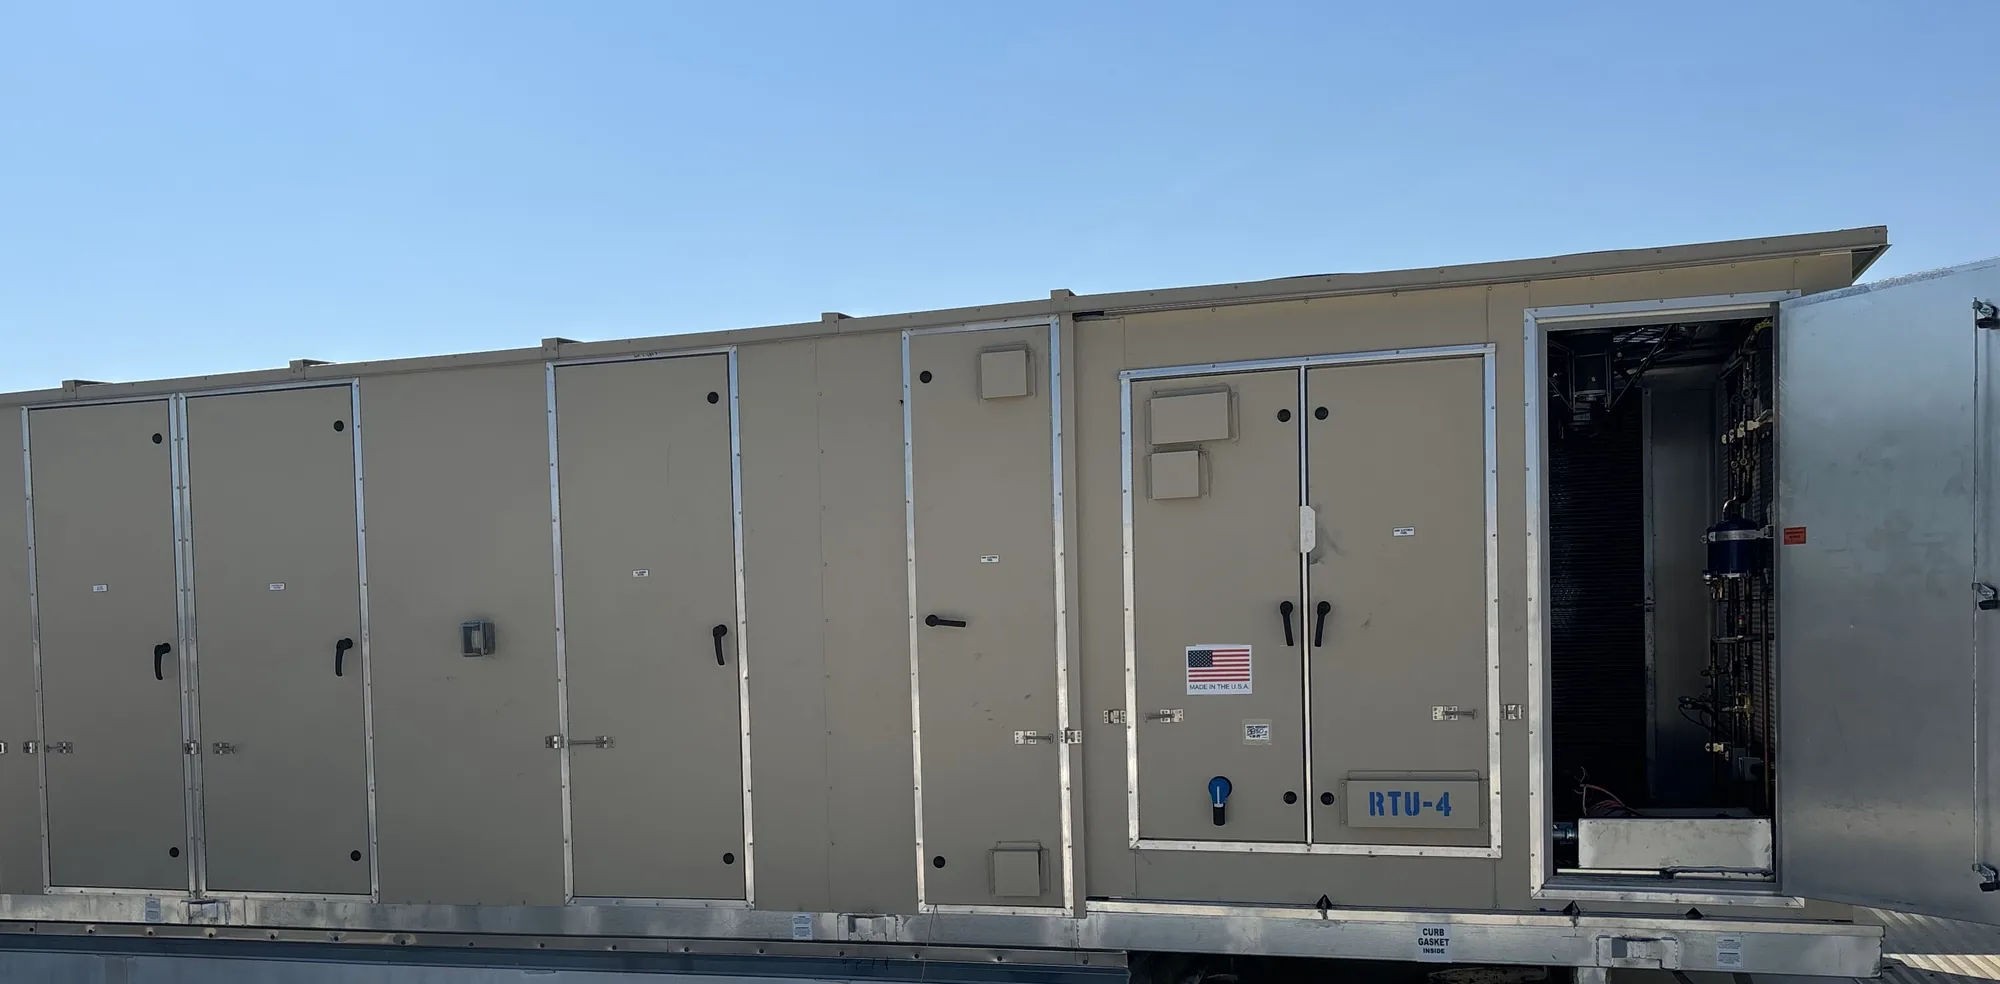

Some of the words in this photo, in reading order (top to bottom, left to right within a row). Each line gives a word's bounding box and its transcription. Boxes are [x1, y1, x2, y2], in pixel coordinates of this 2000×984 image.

[1369, 791, 1452, 816] RTU-4
[1422, 928, 1445, 936] CURB
[1418, 938, 1450, 946] GASKET
